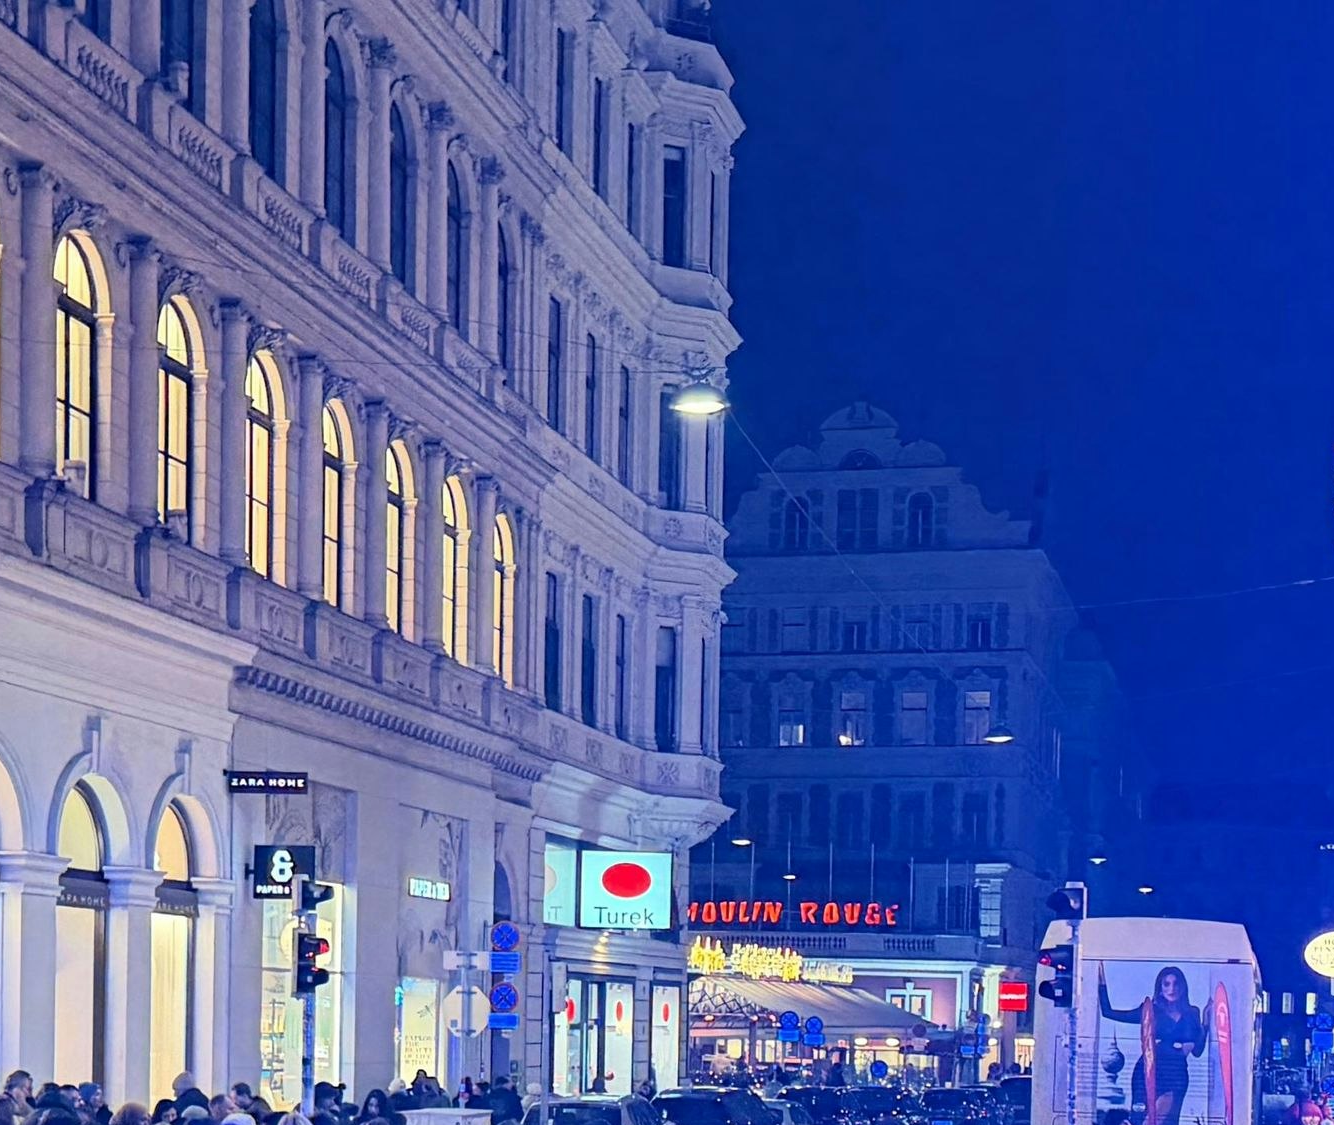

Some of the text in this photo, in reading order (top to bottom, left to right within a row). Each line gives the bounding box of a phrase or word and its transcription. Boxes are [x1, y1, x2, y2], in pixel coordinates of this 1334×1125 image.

[231, 778, 305, 787] ZARA HOME
[256, 885, 283, 894] PAPER
[60, 893, 78, 904] ARA
[594, 906, 654, 926] Turek
[800, 902, 899, 925] ROUGE
